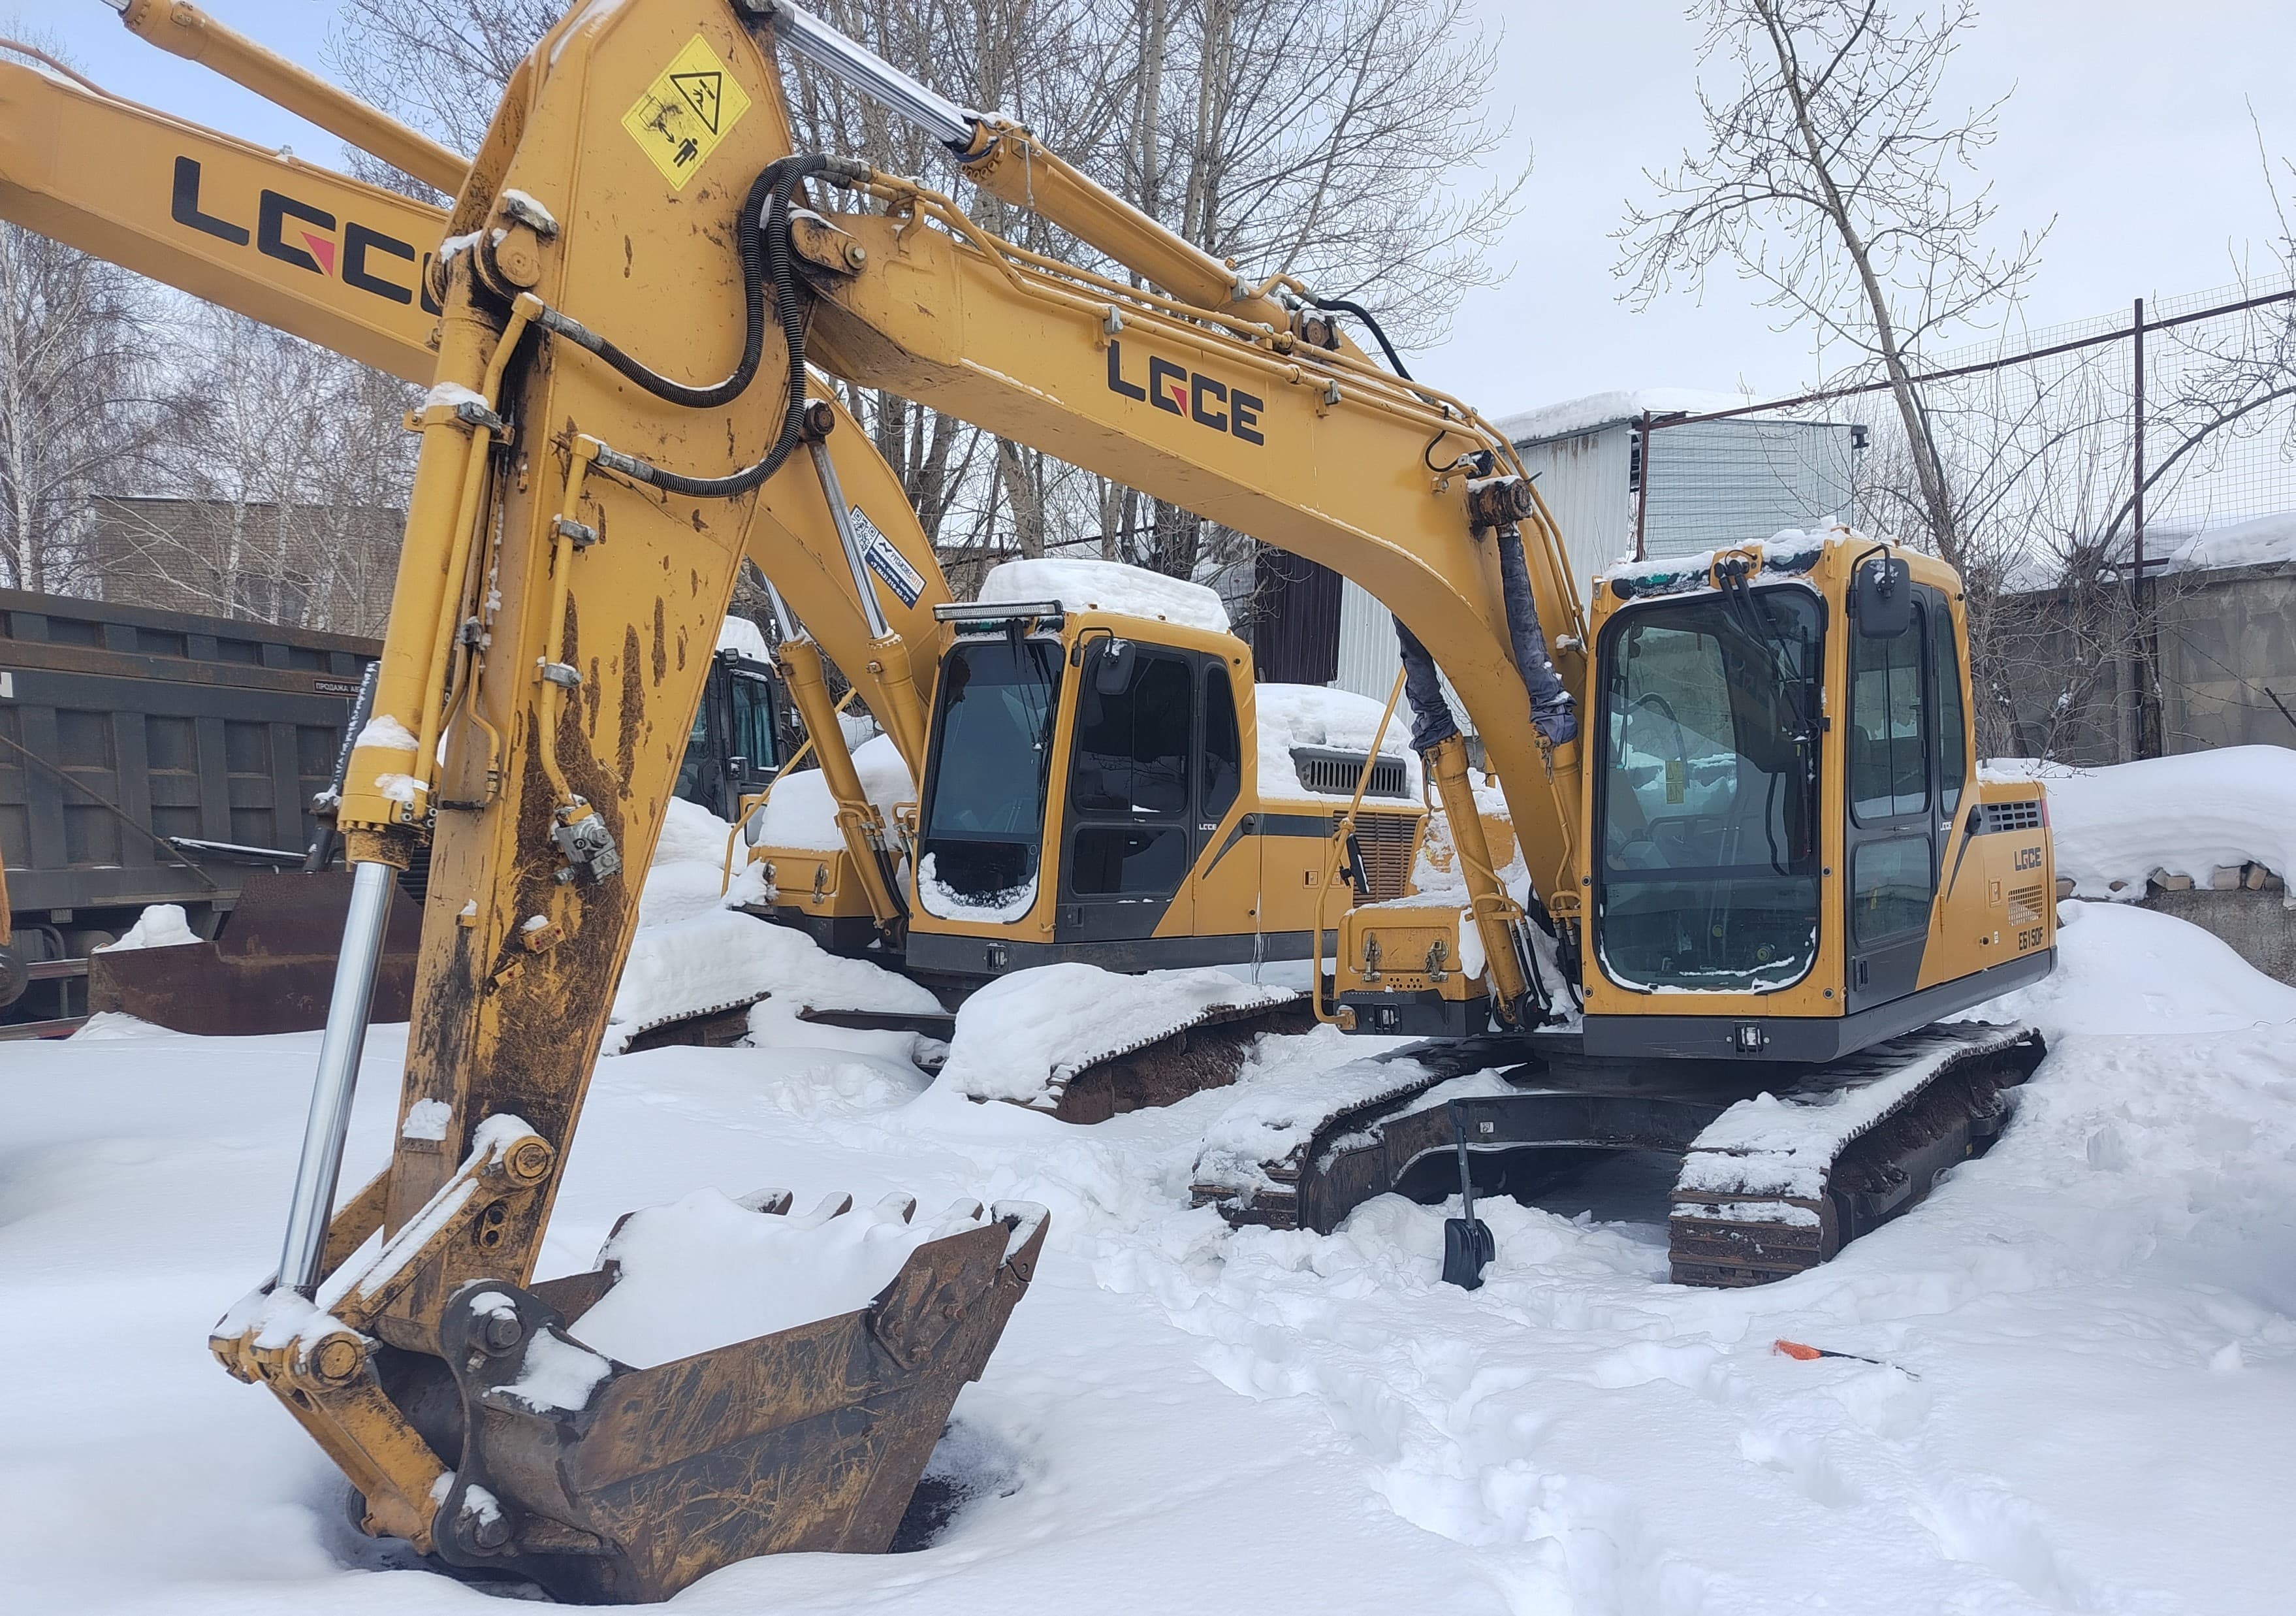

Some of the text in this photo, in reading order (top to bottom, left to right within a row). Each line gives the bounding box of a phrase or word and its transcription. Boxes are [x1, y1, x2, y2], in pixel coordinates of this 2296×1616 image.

[171, 155, 445, 315] LGC
[1107, 338, 1265, 447] LGCE
[2014, 847, 2041, 871] LGCE
